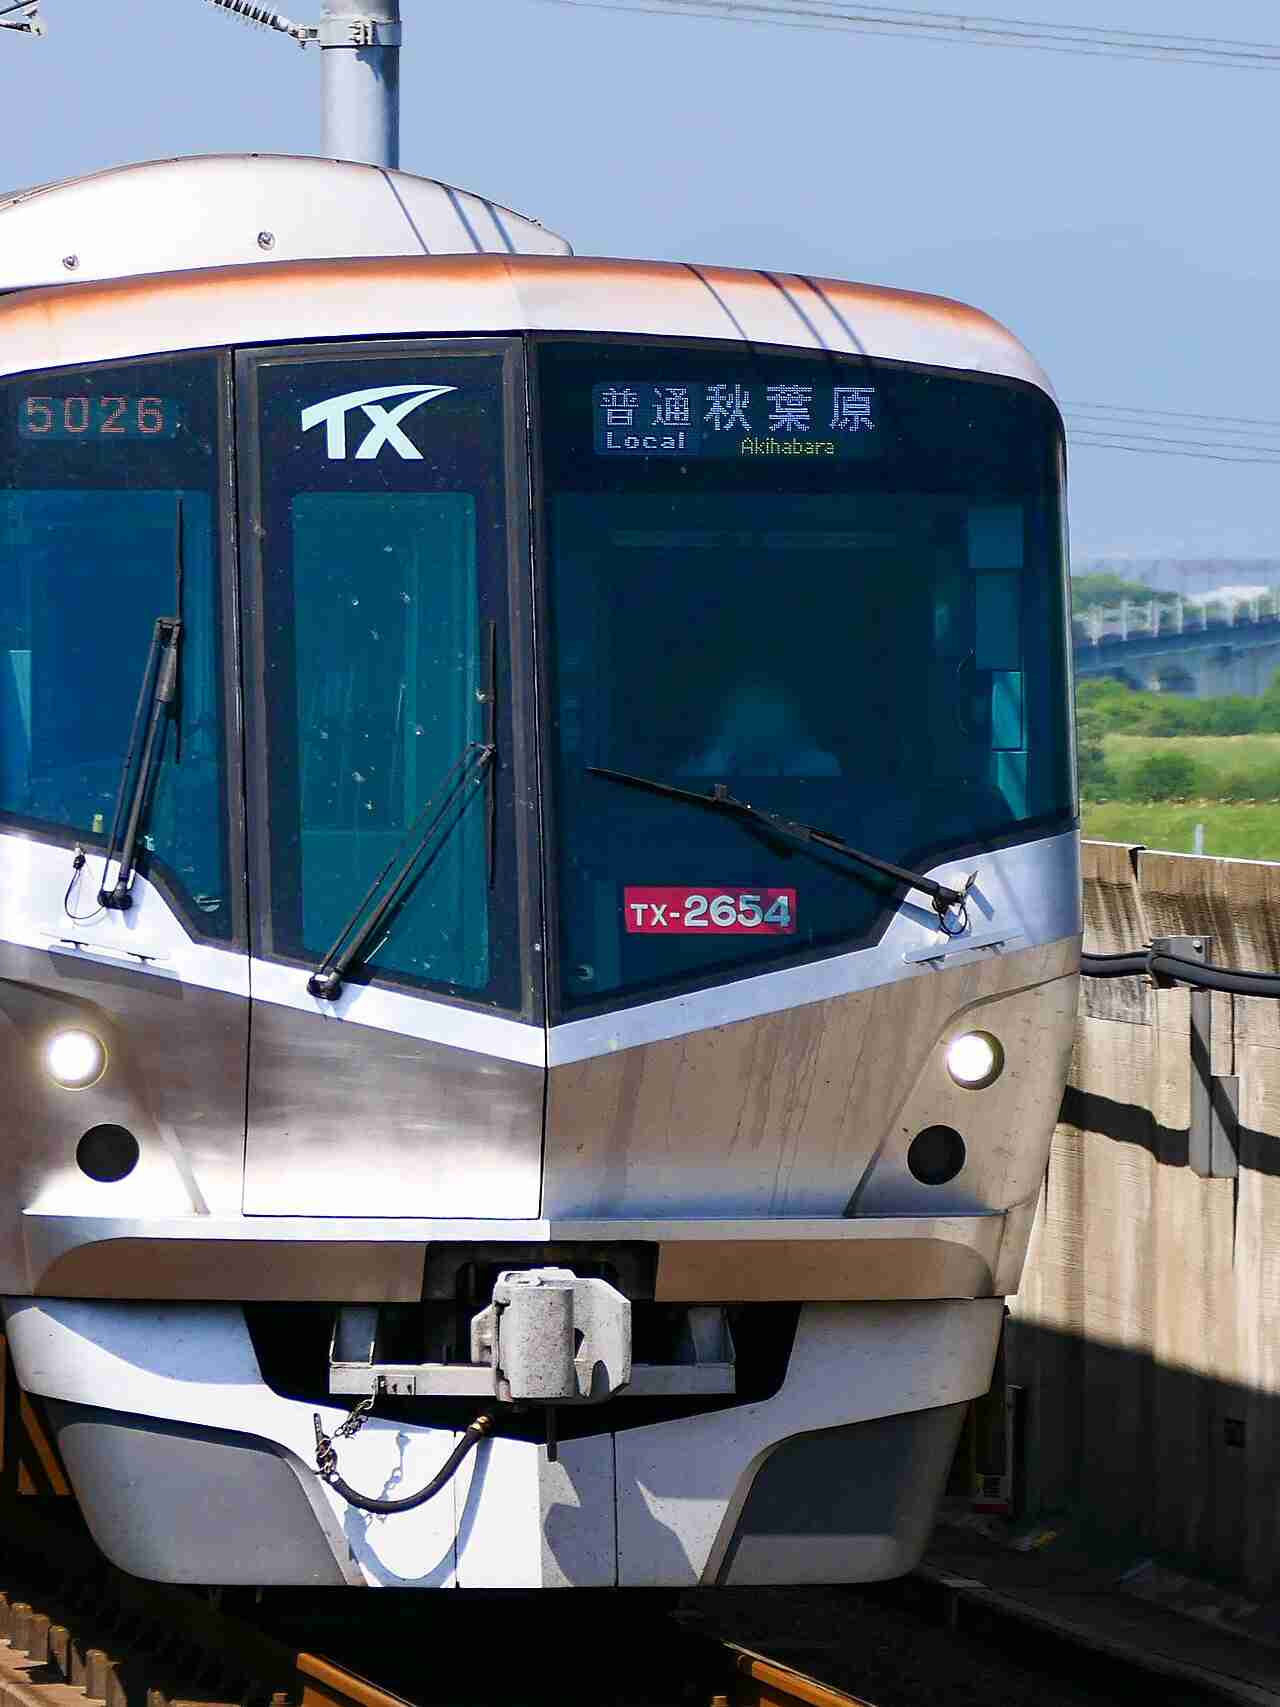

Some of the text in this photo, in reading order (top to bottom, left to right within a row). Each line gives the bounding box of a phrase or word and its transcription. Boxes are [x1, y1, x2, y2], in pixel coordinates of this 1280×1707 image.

[27, 396, 163, 433] 5026
[301, 384, 459, 459] TX
[600, 384, 876, 432] 普通 秋葉原
[607, 431, 685, 449] Local
[741, 438, 835, 455] Akihabara
[630, 895, 791, 927] TX-2654
